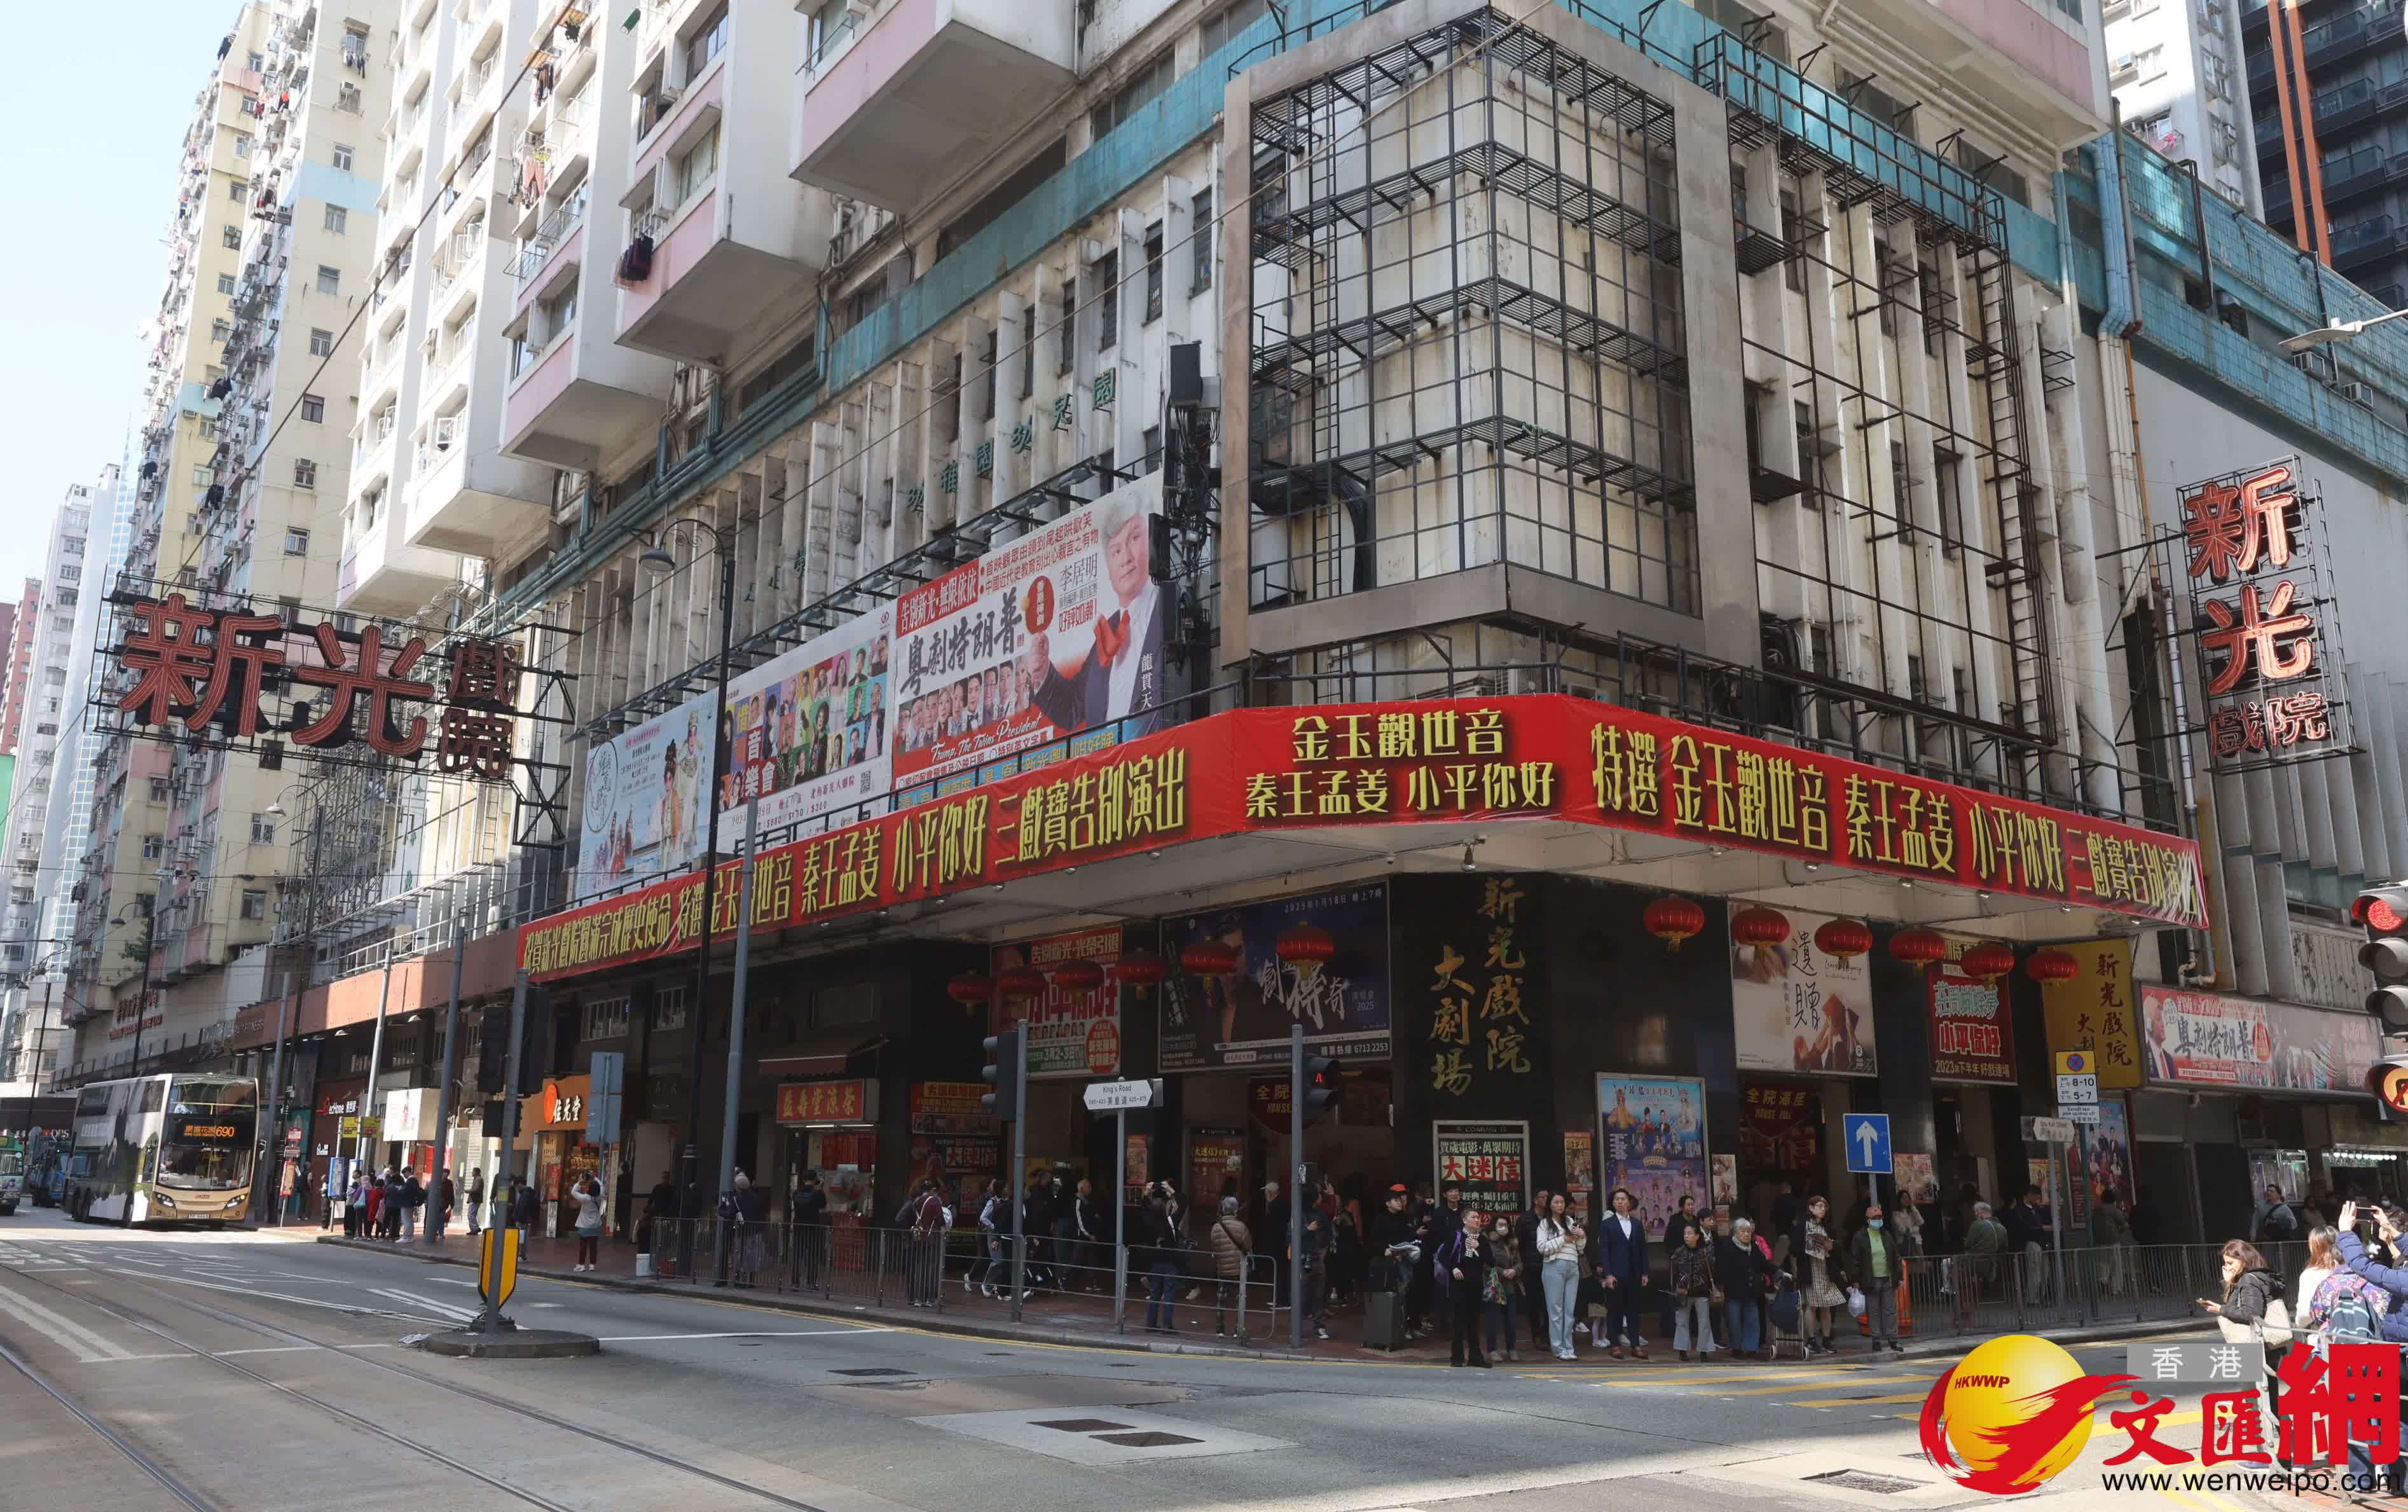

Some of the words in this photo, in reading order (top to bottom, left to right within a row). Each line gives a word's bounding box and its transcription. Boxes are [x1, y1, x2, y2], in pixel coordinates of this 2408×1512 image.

[1059, 553, 1098, 592] 李居明
[2185, 466, 2313, 694] 新光
[900, 586, 1022, 696] 粵劇特朗普
[120, 592, 435, 758] 新光
[439, 638, 514, 779] 戲院
[1142, 653, 1153, 710] 龍貫天
[959, 738, 971, 755] The
[996, 711, 1043, 742] President
[1291, 708, 1505, 763] 金玉觀世音
[2208, 691, 2329, 758] 戲院
[1246, 767, 1389, 818] 秦王孟姜
[1406, 760, 1556, 812] 小平你好
[1590, 722, 1659, 817] 特選
[1670, 734, 1829, 853] 金玉觀世音
[1843, 772, 1956, 874] 秦王孟姜
[1969, 801, 2065, 893] 小平你好
[677, 882, 705, 941] 特選
[801, 823, 881, 915] 秦王孟姜
[892, 792, 989, 895] 小平你好
[994, 745, 1185, 865] 三戲寶告別演出
[1477, 877, 1531, 1074] 新光戲院
[1429, 945, 1476, 1096] 大劇場
[2095, 953, 2132, 1068] 新光戲院
[1103, 1086, 1118, 1094] King's
[1108, 1096, 1127, 1106] 英皇道
[2073, 1078, 2095, 1087] 8-10
[216, 1125, 235, 1137] 690
[1443, 1155, 1522, 1181] 大迷信
